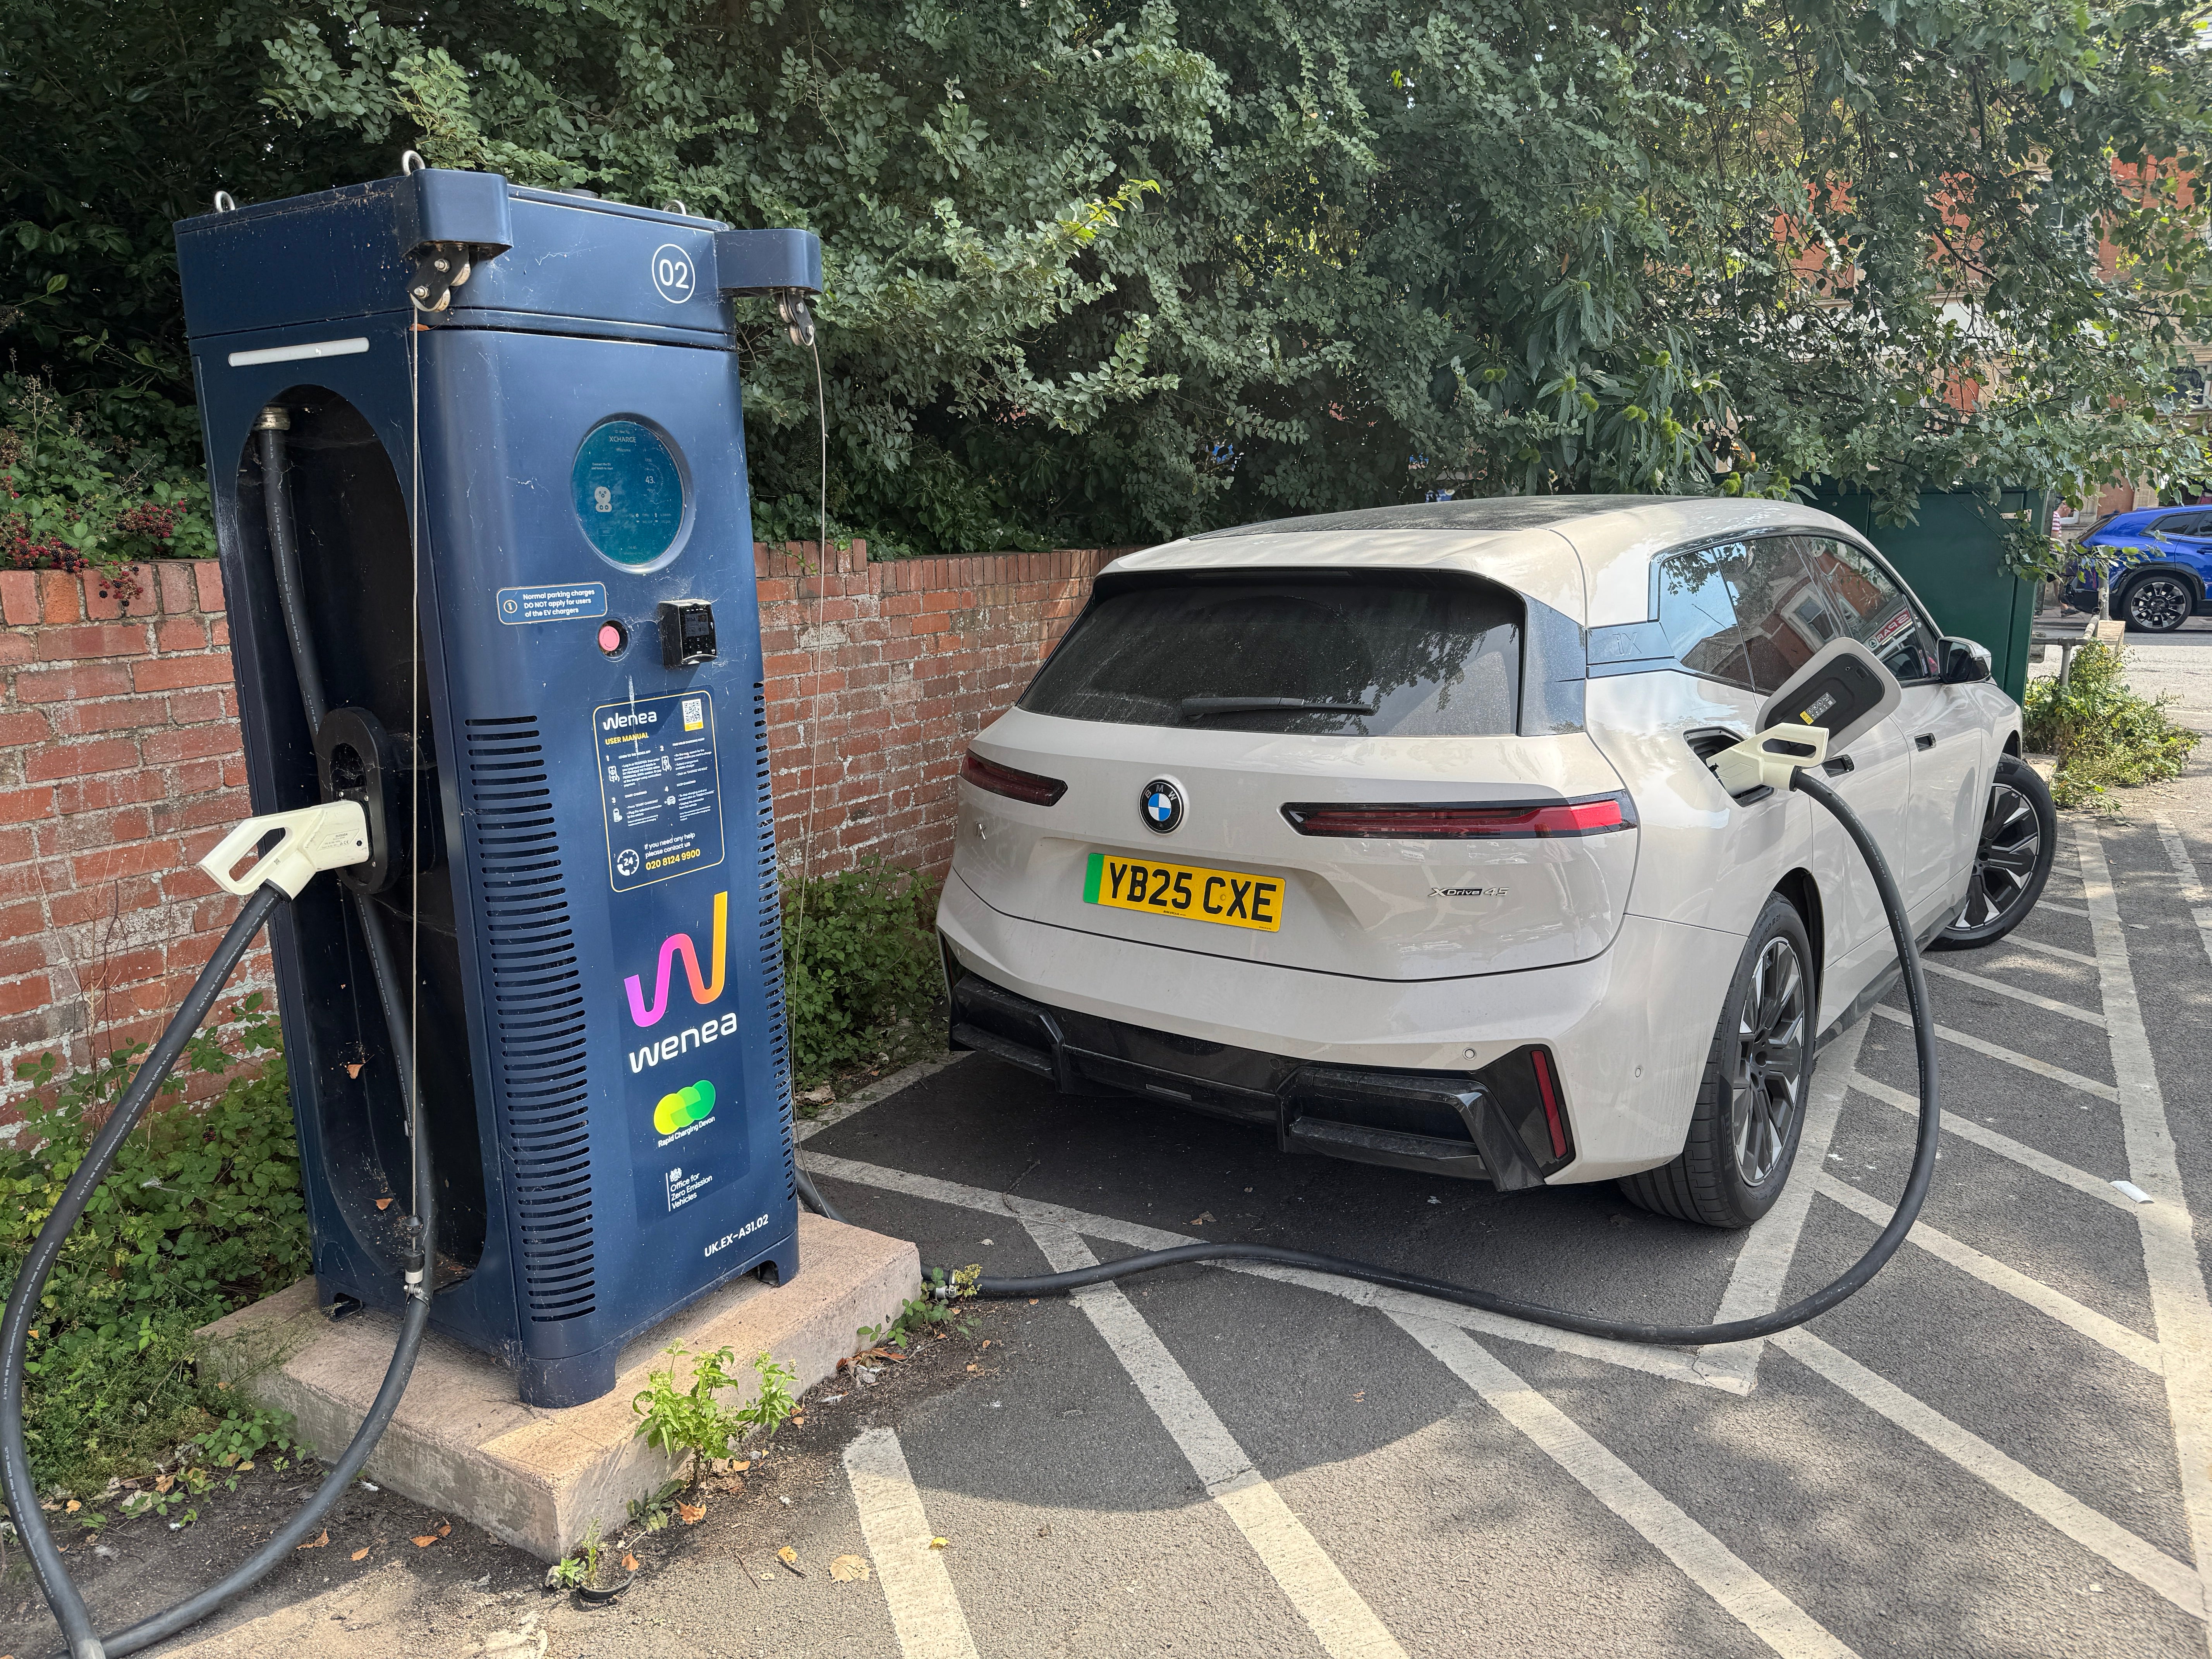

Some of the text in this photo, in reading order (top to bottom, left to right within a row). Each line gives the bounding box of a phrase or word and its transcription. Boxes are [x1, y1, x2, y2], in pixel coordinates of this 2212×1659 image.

[659, 259, 689, 289] 02
[547, 591, 570, 600] parking
[605, 732, 649, 745] USER MANUAL
[1145, 784, 1177, 801] BMW
[645, 849, 663, 859] please
[664, 843, 684, 853] contact
[649, 842, 659, 850] you
[660, 837, 673, 846] need
[623, 857, 634, 866] 24
[646, 848, 701, 870] 020 8124 9900
[1109, 862, 1277, 923] YB25 CXE
[1484, 888, 1509, 896] 45
[658, 1116, 715, 1148] Rapid Charging Devon
[670, 1173, 700, 1192] Office for
[671, 1175, 713, 1201] Zero Emission
[672, 1192, 697, 1209] Vehicles
[704, 1214, 768, 1257] UK.EX-A31.02
